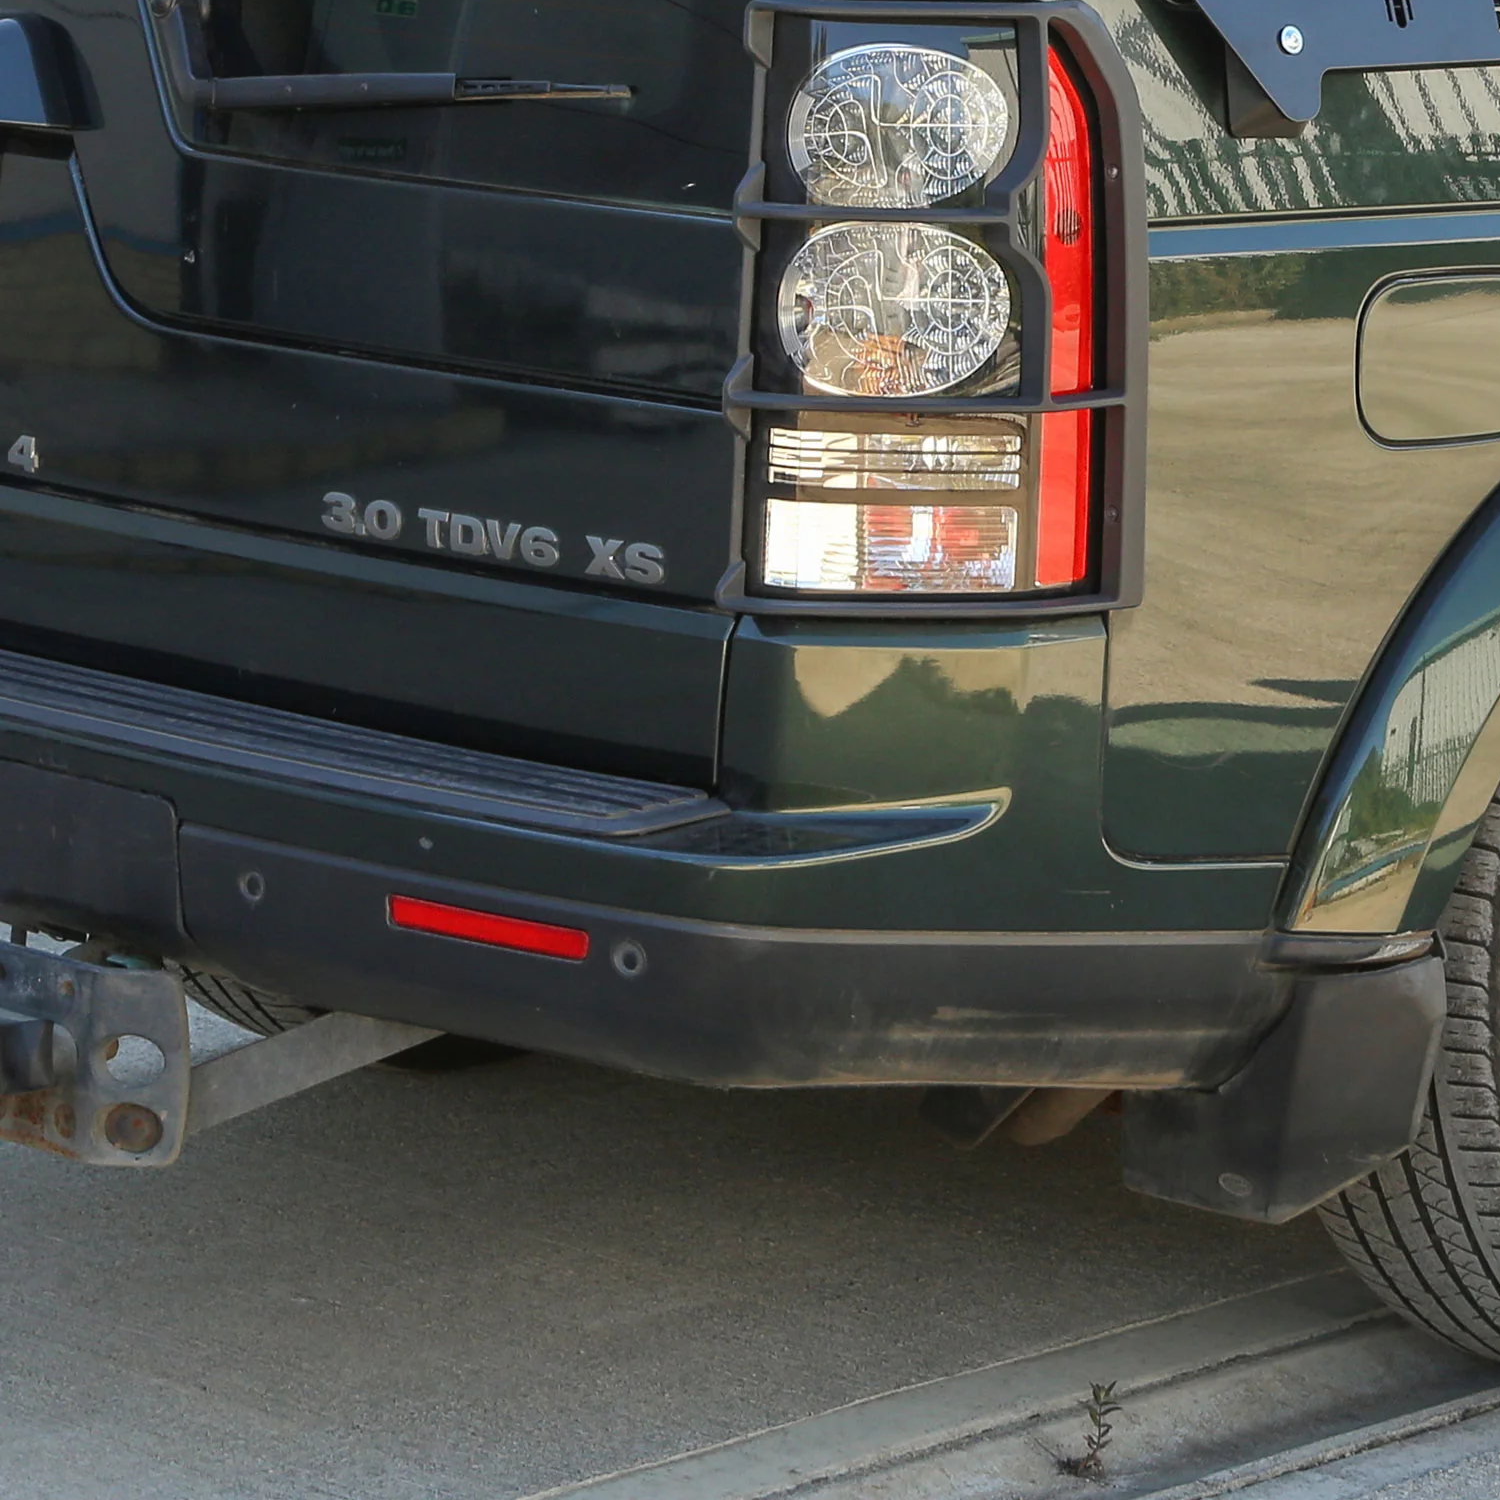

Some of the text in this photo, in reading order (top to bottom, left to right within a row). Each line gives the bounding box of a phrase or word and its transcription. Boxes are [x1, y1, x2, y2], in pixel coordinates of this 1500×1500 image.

[7, 434, 39, 474] 4
[320, 490, 666, 585] 3.0 TDV6 XS
